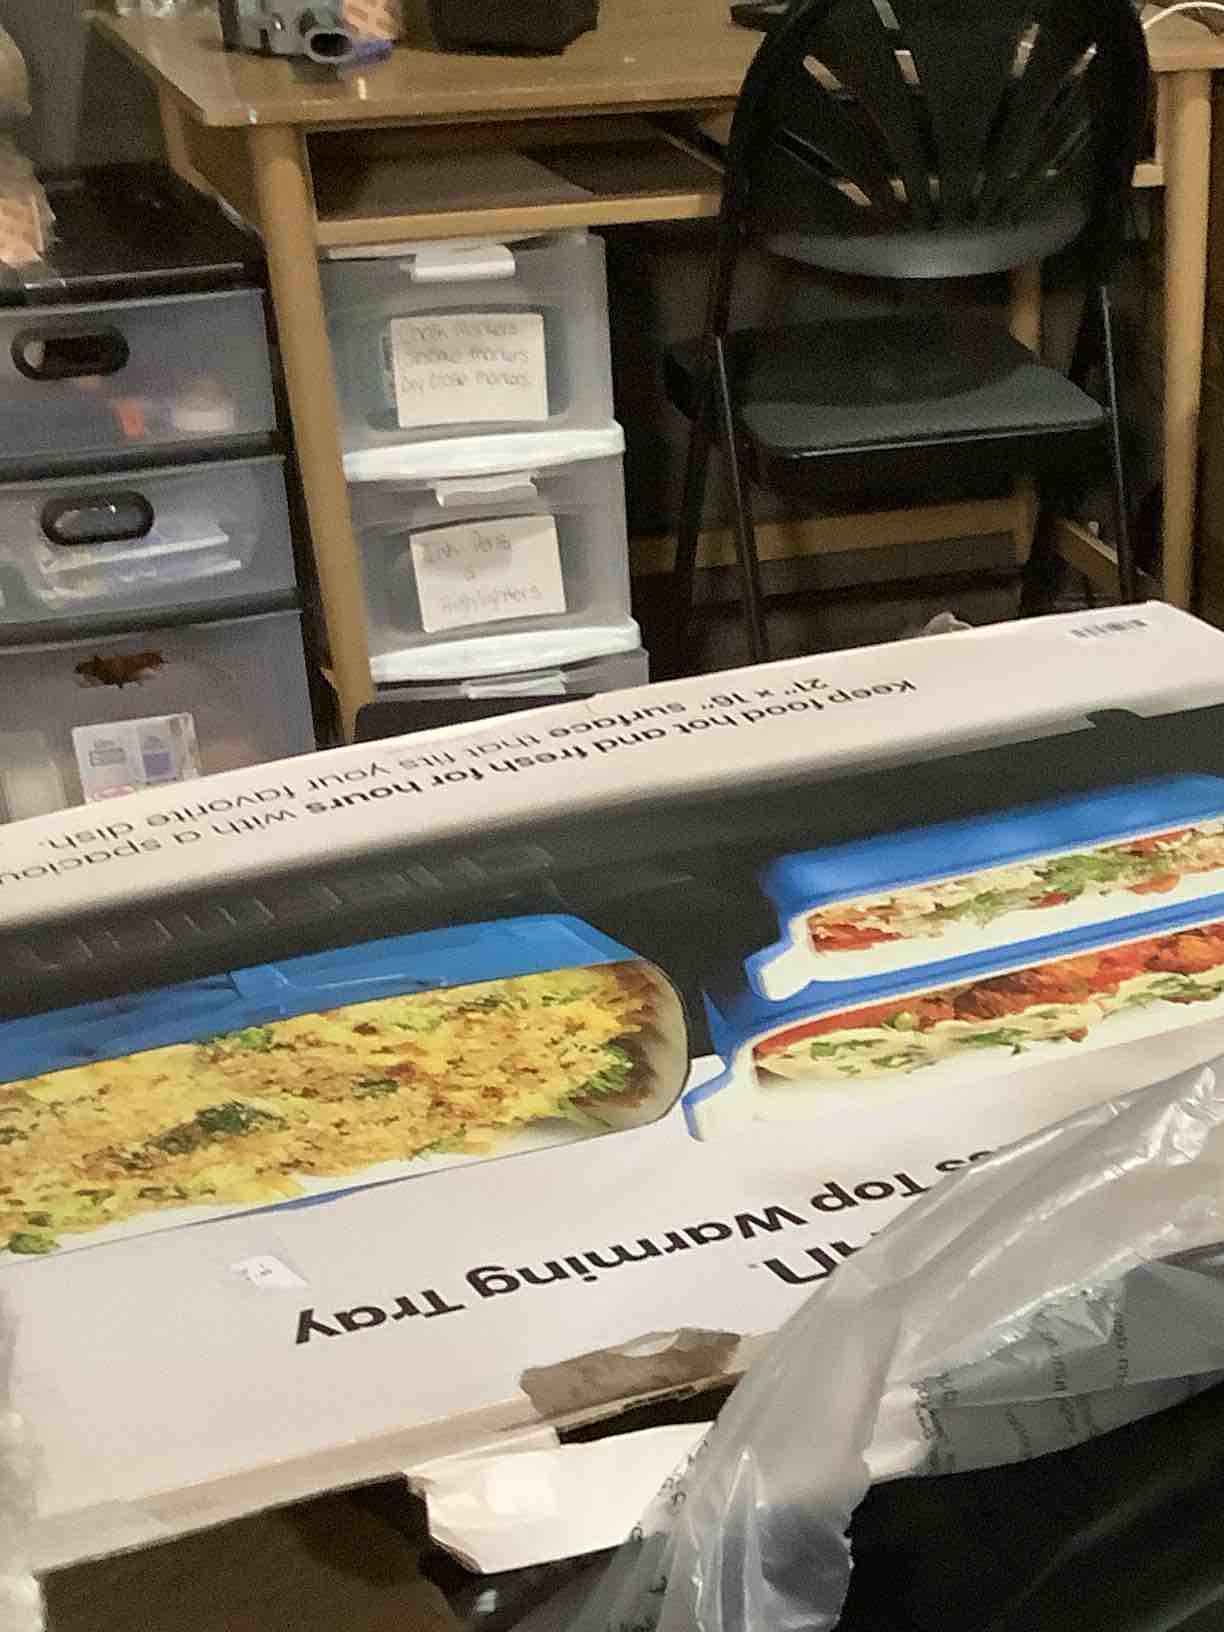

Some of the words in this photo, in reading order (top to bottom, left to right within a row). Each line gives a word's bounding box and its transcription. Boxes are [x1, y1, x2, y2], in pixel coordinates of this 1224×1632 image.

[828, 679, 918, 706] Keep
[549, 701, 688, 738] surface
[672, 703, 740, 734] hot
[748, 696, 826, 725] food
[469, 732, 543, 760] that
[592, 726, 667, 754] and
[399, 749, 457, 773] fits
[488, 740, 590, 773] fresh
[306, 761, 393, 791] your
[431, 759, 484, 788] for
[146, 785, 298, 826] favorite
[305, 780, 425, 815] hours
[41, 822, 136, 850] dish.
[174, 827, 201, 846] a
[211, 807, 298, 837] with
[0, 838, 162, 884] spaciou
[810, 1172, 932, 1212] Top
[465, 1205, 809, 1298] Warming
[296, 1289, 466, 1344] Tray
